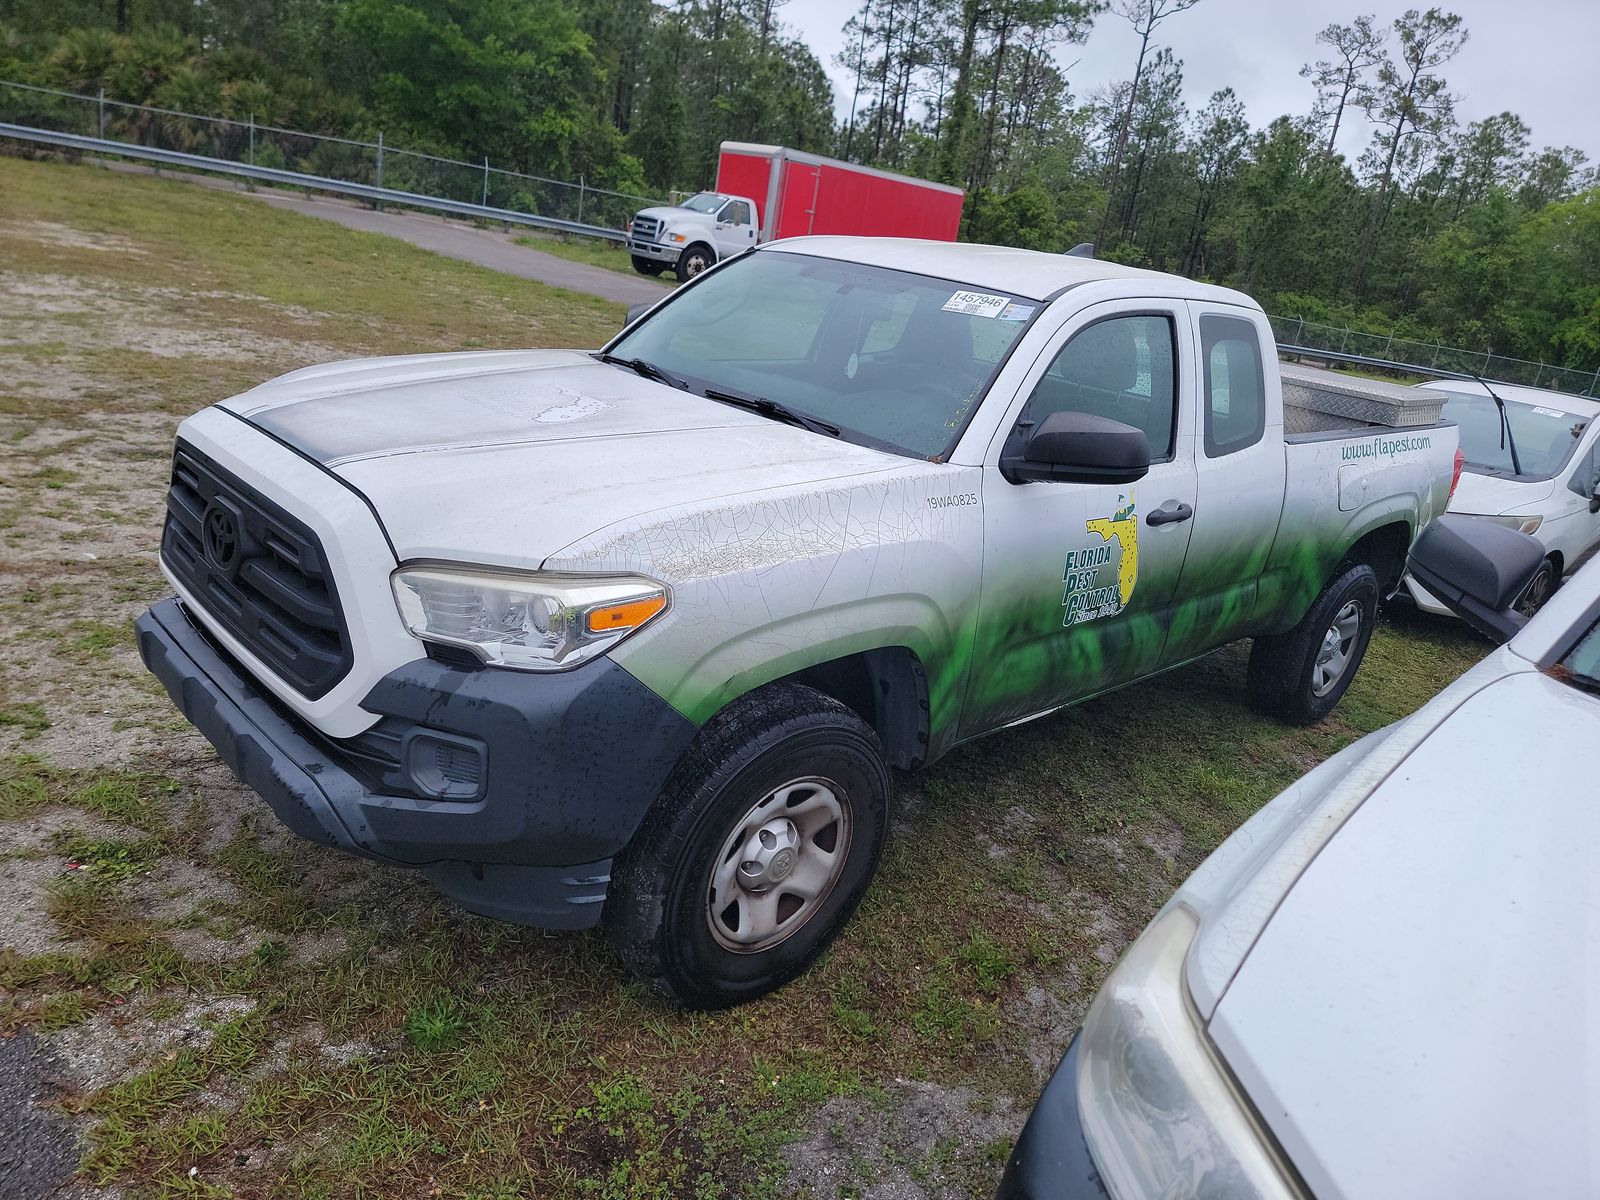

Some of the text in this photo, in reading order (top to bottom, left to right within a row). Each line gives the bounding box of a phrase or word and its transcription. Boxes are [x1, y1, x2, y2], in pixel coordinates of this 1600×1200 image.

[953, 293, 1004, 308] 1457946
[1342, 436, 1432, 460] www.flapest.com
[927, 493, 978, 509] 19WA0825
